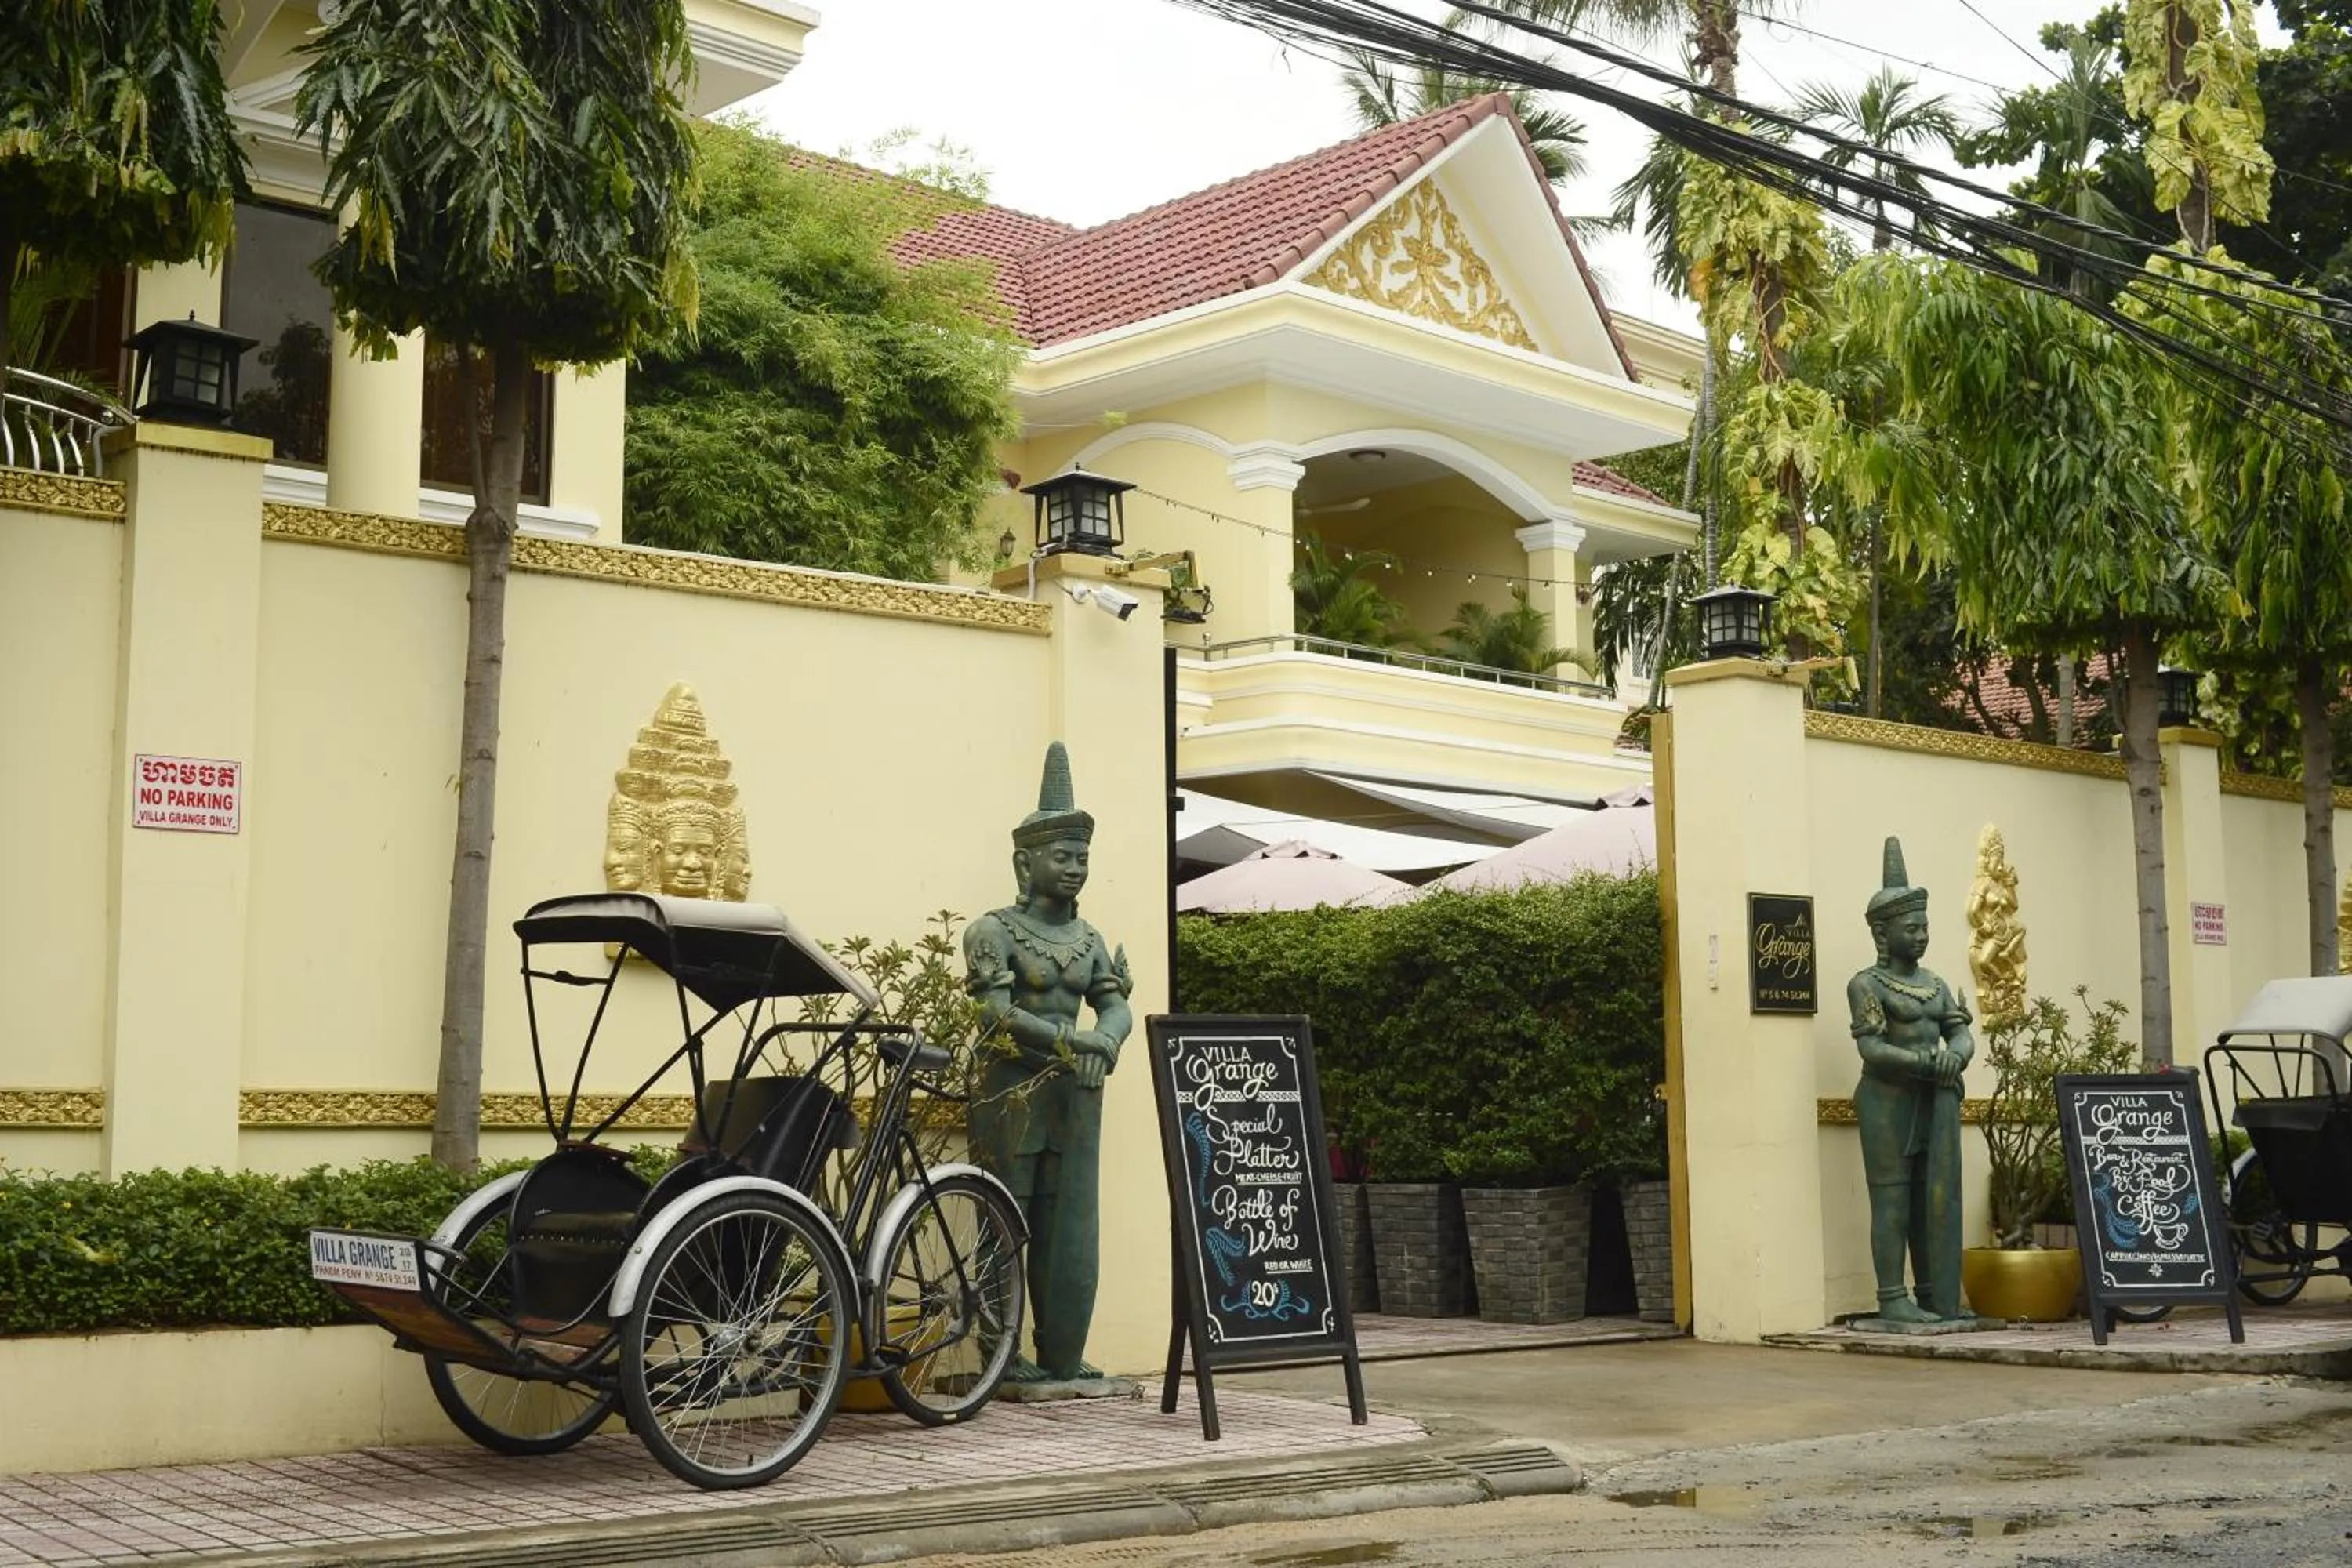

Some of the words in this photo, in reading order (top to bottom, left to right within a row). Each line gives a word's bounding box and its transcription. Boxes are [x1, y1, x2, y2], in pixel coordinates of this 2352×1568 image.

[139, 809, 165, 822] VILLA
[169, 812, 206, 826] GRANGE
[209, 815, 233, 827] ONLY
[140, 788, 162, 804] NO
[167, 789, 233, 811] PARKING
[1755, 923, 1812, 979] Grange
[1201, 1046, 1254, 1062] VILLA
[1185, 1054, 1279, 1112] Grange
[2110, 1096, 2148, 1108] VILLA
[1205, 1103, 1283, 1145] Special
[2091, 1104, 2173, 1145] Grange
[1214, 1136, 1300, 1176] Platter
[2129, 1164, 2191, 1200] Pool
[1212, 1185, 1274, 1230] Bottle
[1279, 1188, 1300, 1232] of
[2118, 1189, 2180, 1235] Coffee
[314, 1237, 347, 1265] VILLA
[349, 1241, 397, 1270] GRANGE
[1242, 1219, 1299, 1258] Wine
